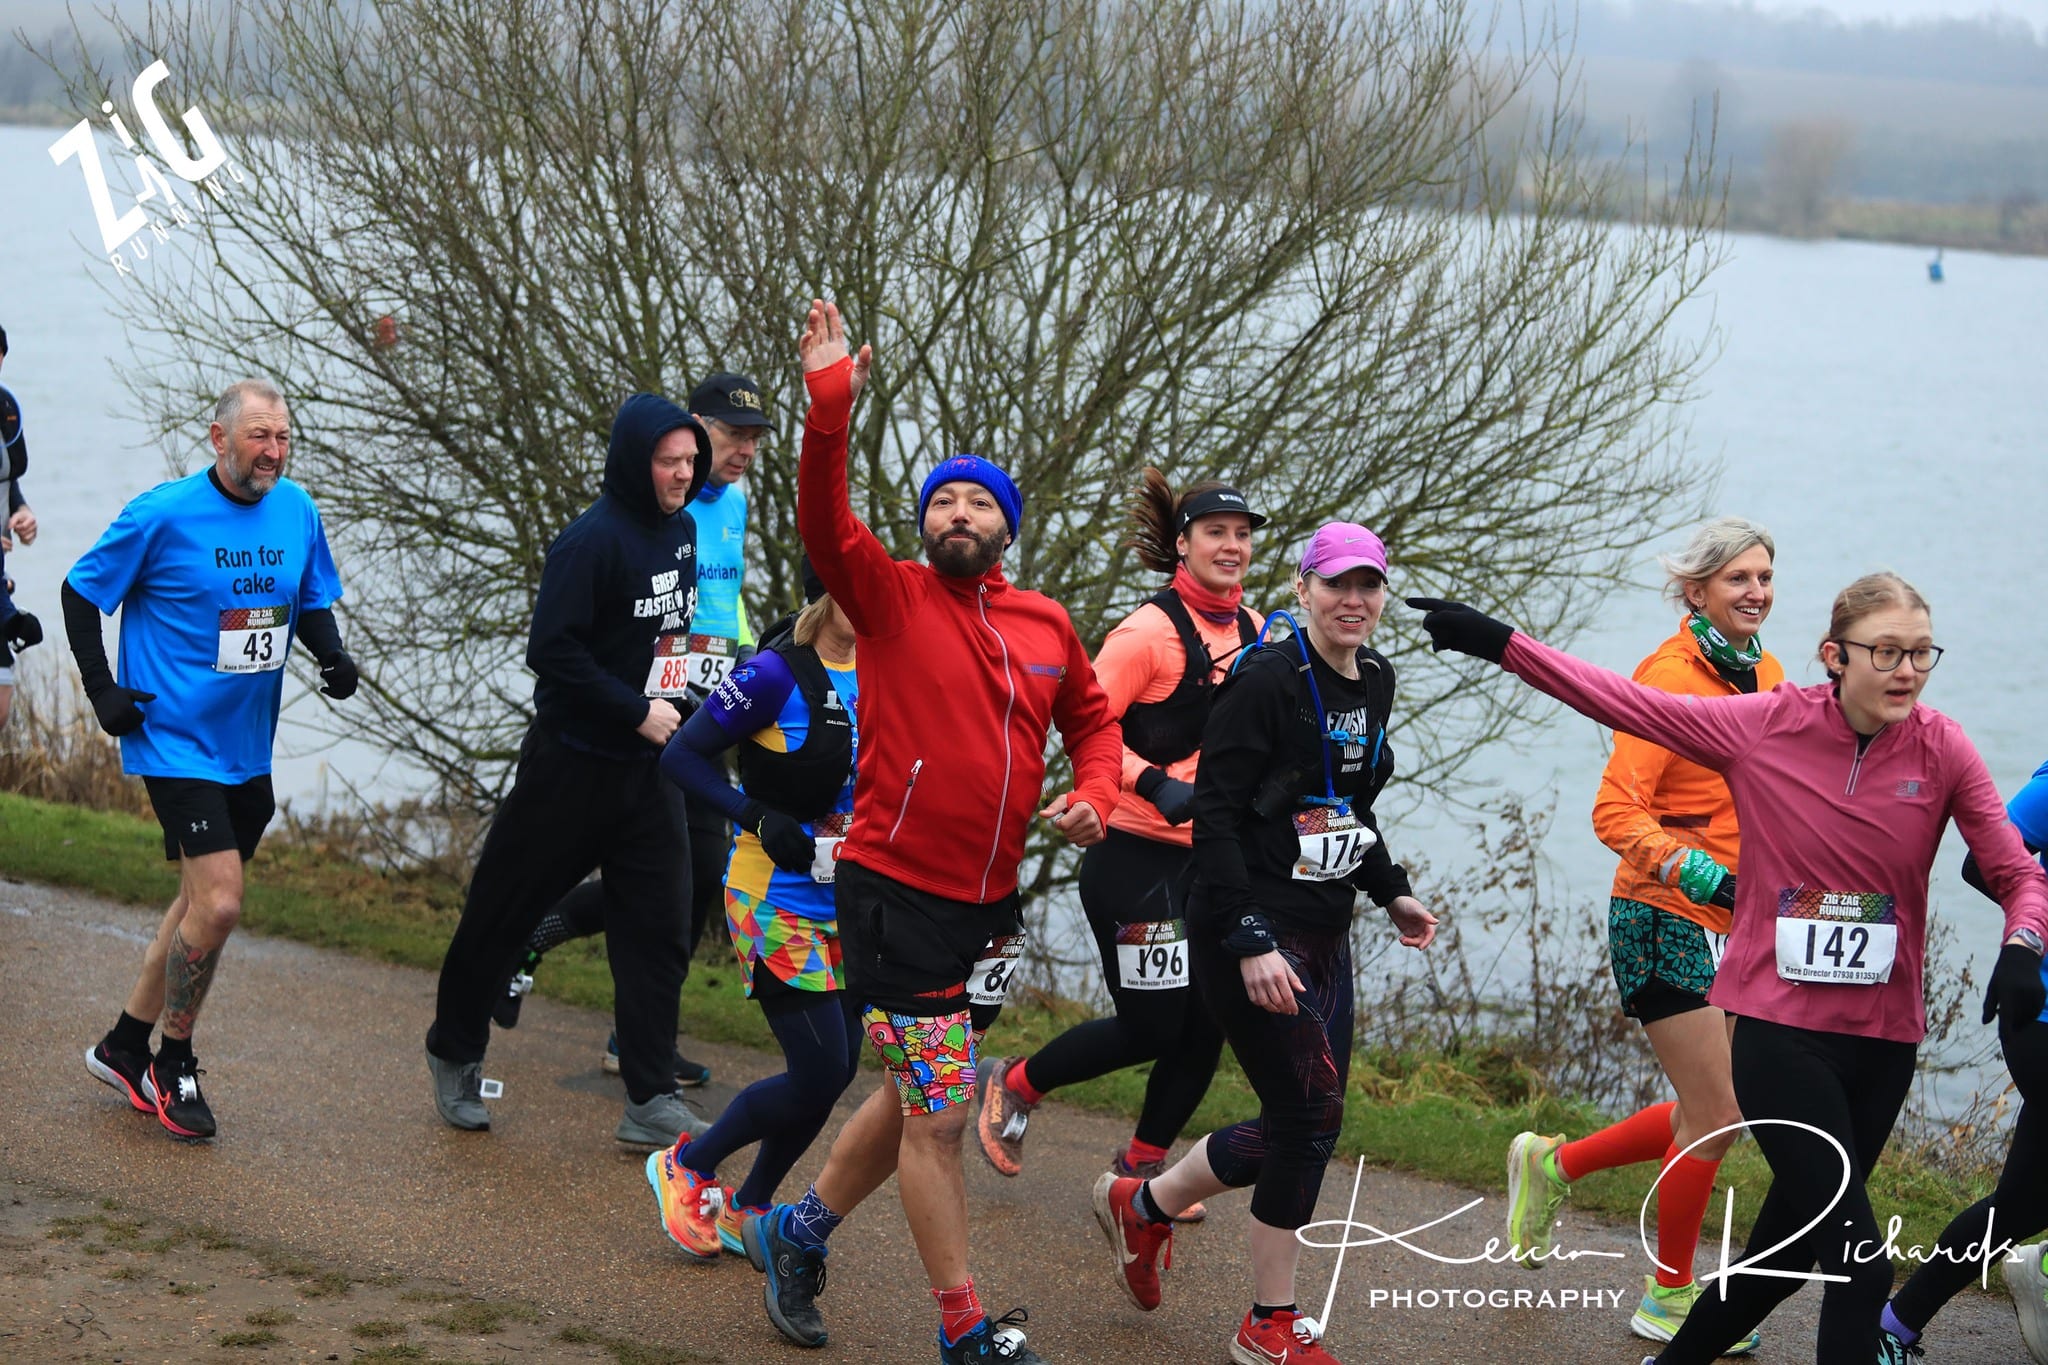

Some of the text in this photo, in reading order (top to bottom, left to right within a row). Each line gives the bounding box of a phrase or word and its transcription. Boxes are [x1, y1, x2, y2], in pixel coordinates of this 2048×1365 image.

[215, 545, 285, 568] Run for
[232, 572, 276, 595] cake
[697, 563, 738, 580] Adrian
[243, 631, 273, 662] 43
[660, 658, 688, 689] 885
[701, 657, 724, 685] 95
[1320, 831, 1363, 871] 176
[1819, 904, 1862, 918] RUNNING
[1822, 893, 1860, 906] ZIG ZAG
[1805, 924, 1869, 969] 142
[1138, 945, 1183, 979] 196
[1785, 965, 1802, 976] Race
[1803, 968, 1831, 977] Director
